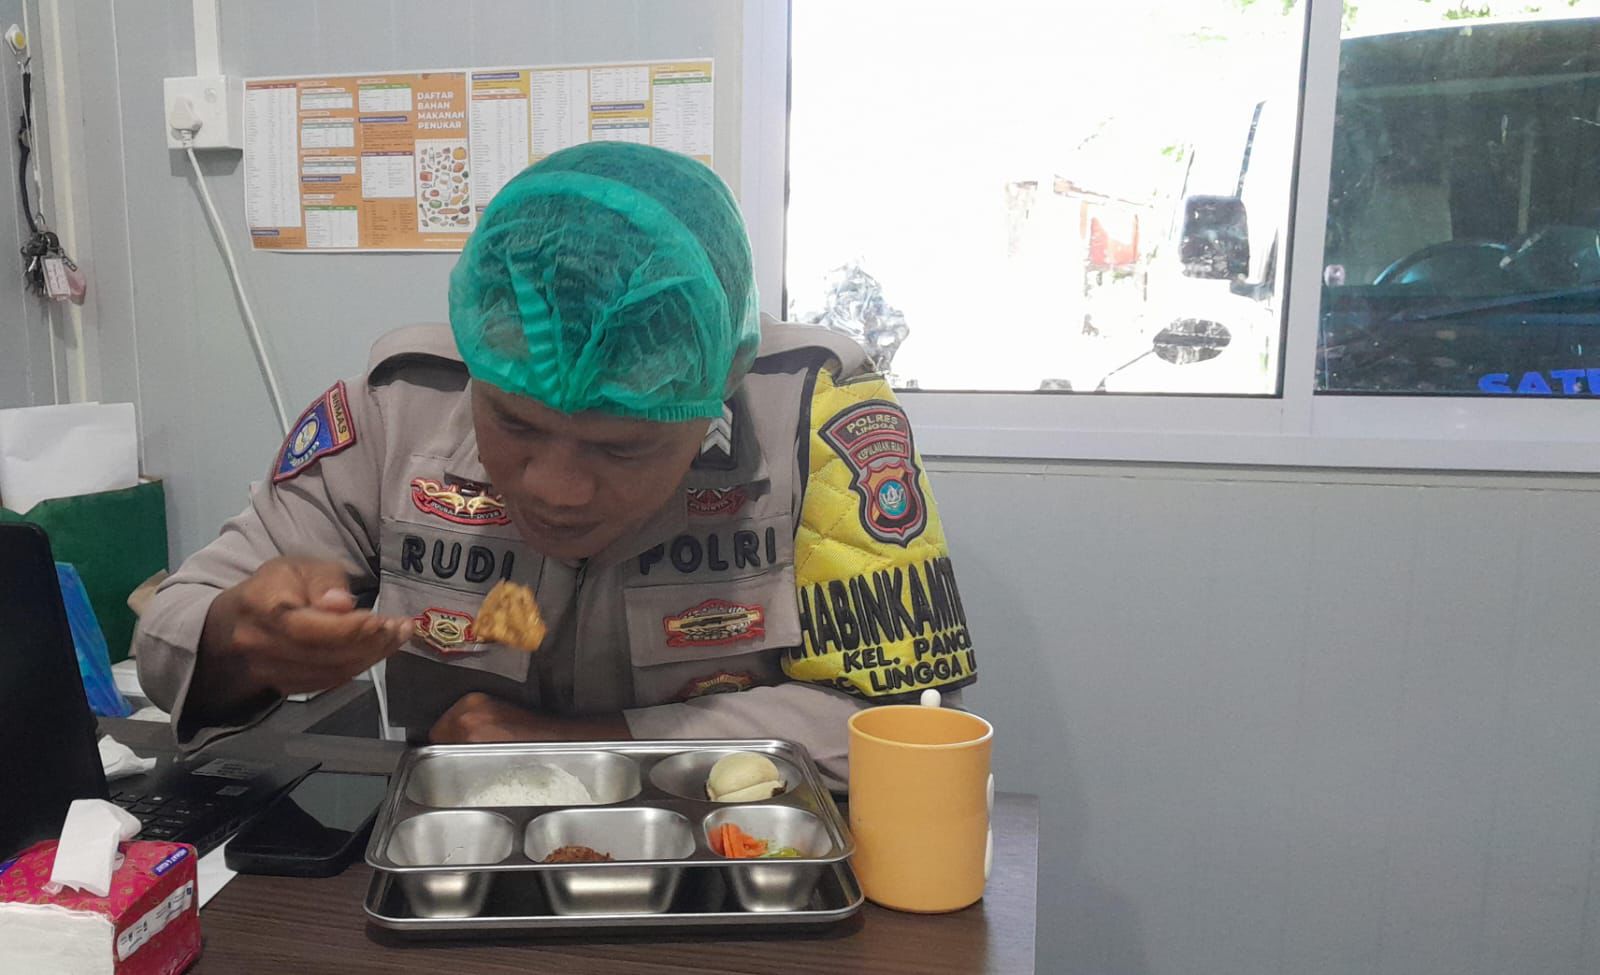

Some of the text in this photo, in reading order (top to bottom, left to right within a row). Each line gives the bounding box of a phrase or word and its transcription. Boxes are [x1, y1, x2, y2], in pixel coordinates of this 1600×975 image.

[417, 91, 454, 100] DAFTAR
[417, 101, 450, 110] BAHAN
[417, 111, 465, 120] MAKANAN
[417, 121, 462, 129] PENUKAR
[846, 414, 896, 433] POLRES
[856, 424, 895, 435] LINGGA
[401, 535, 515, 583] RUDI
[843, 646, 901, 673] KEL.
[870, 655, 963, 692] LINGGA
